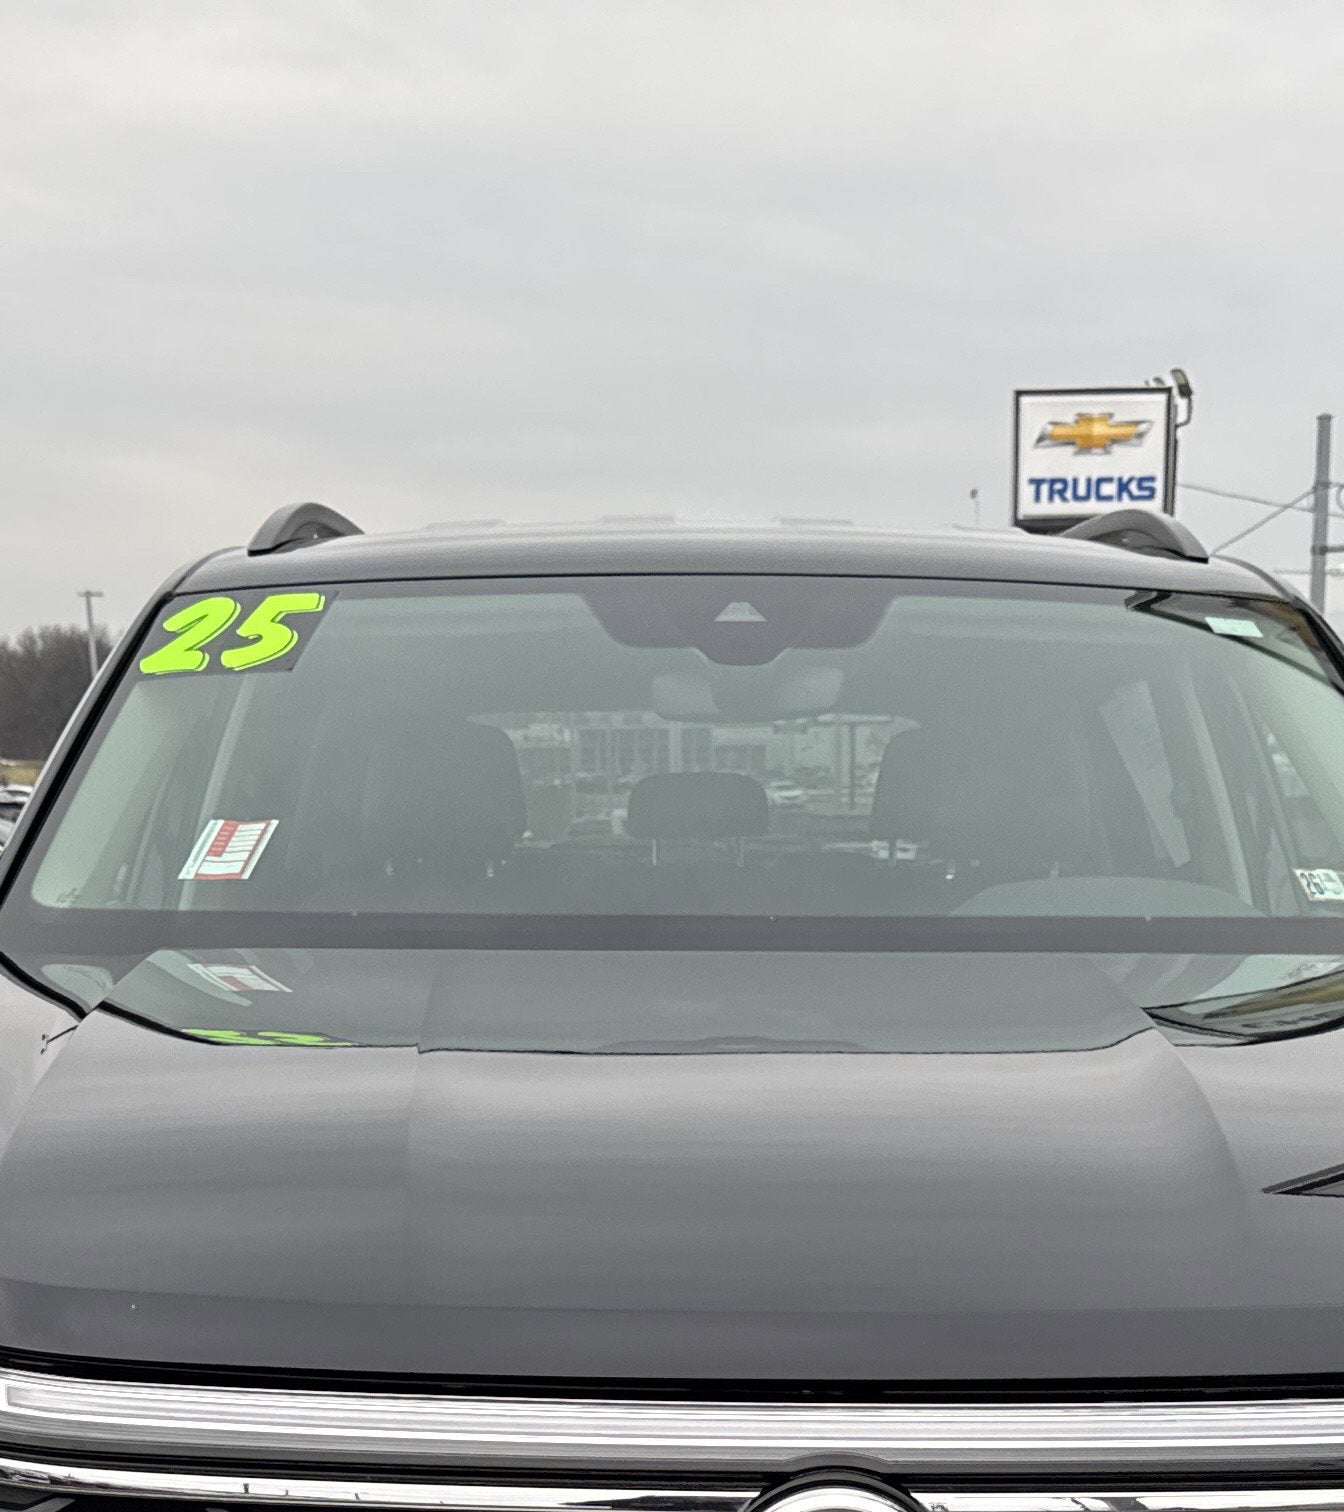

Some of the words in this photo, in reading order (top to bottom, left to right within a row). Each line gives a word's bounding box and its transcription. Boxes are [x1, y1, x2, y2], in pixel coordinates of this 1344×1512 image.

[1028, 475, 1157, 504] TRUCKS
[139, 592, 325, 675] 25
[1299, 872, 1325, 896] 26
